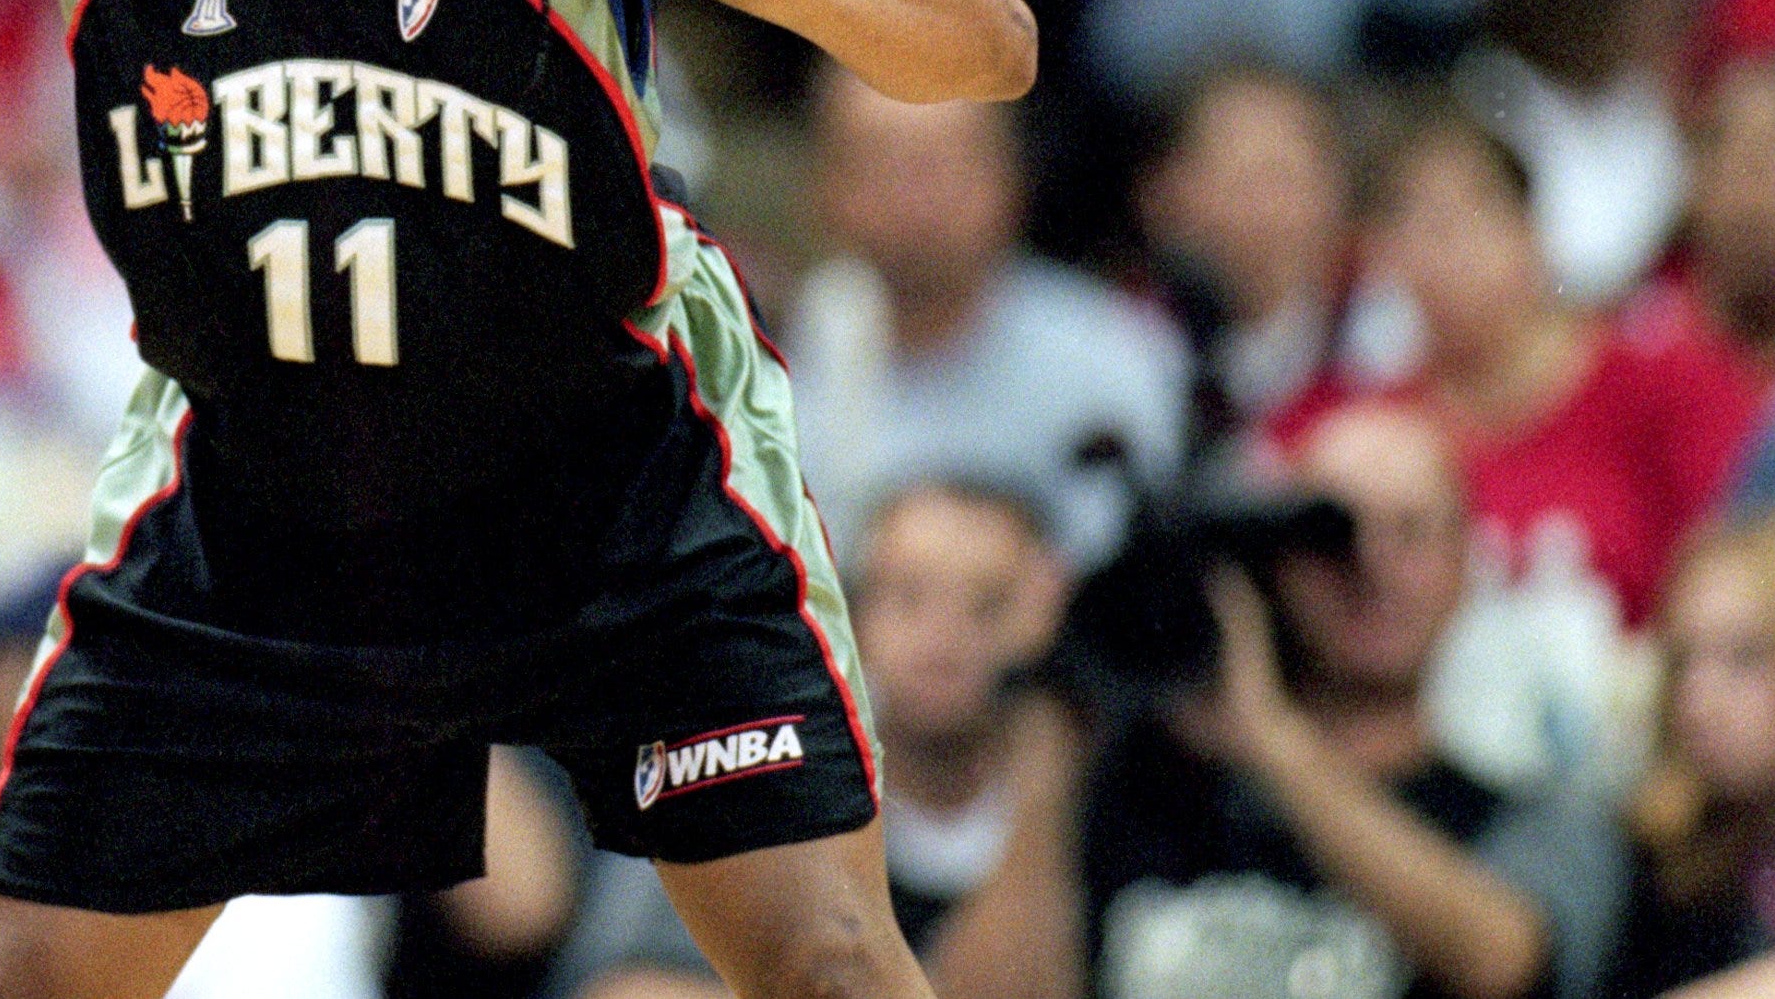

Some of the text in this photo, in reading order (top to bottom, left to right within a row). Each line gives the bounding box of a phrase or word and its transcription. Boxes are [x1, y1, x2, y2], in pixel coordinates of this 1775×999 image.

[109, 58, 576, 250] LIBERTY
[247, 217, 400, 368] 11
[667, 724, 804, 787] WNBA
